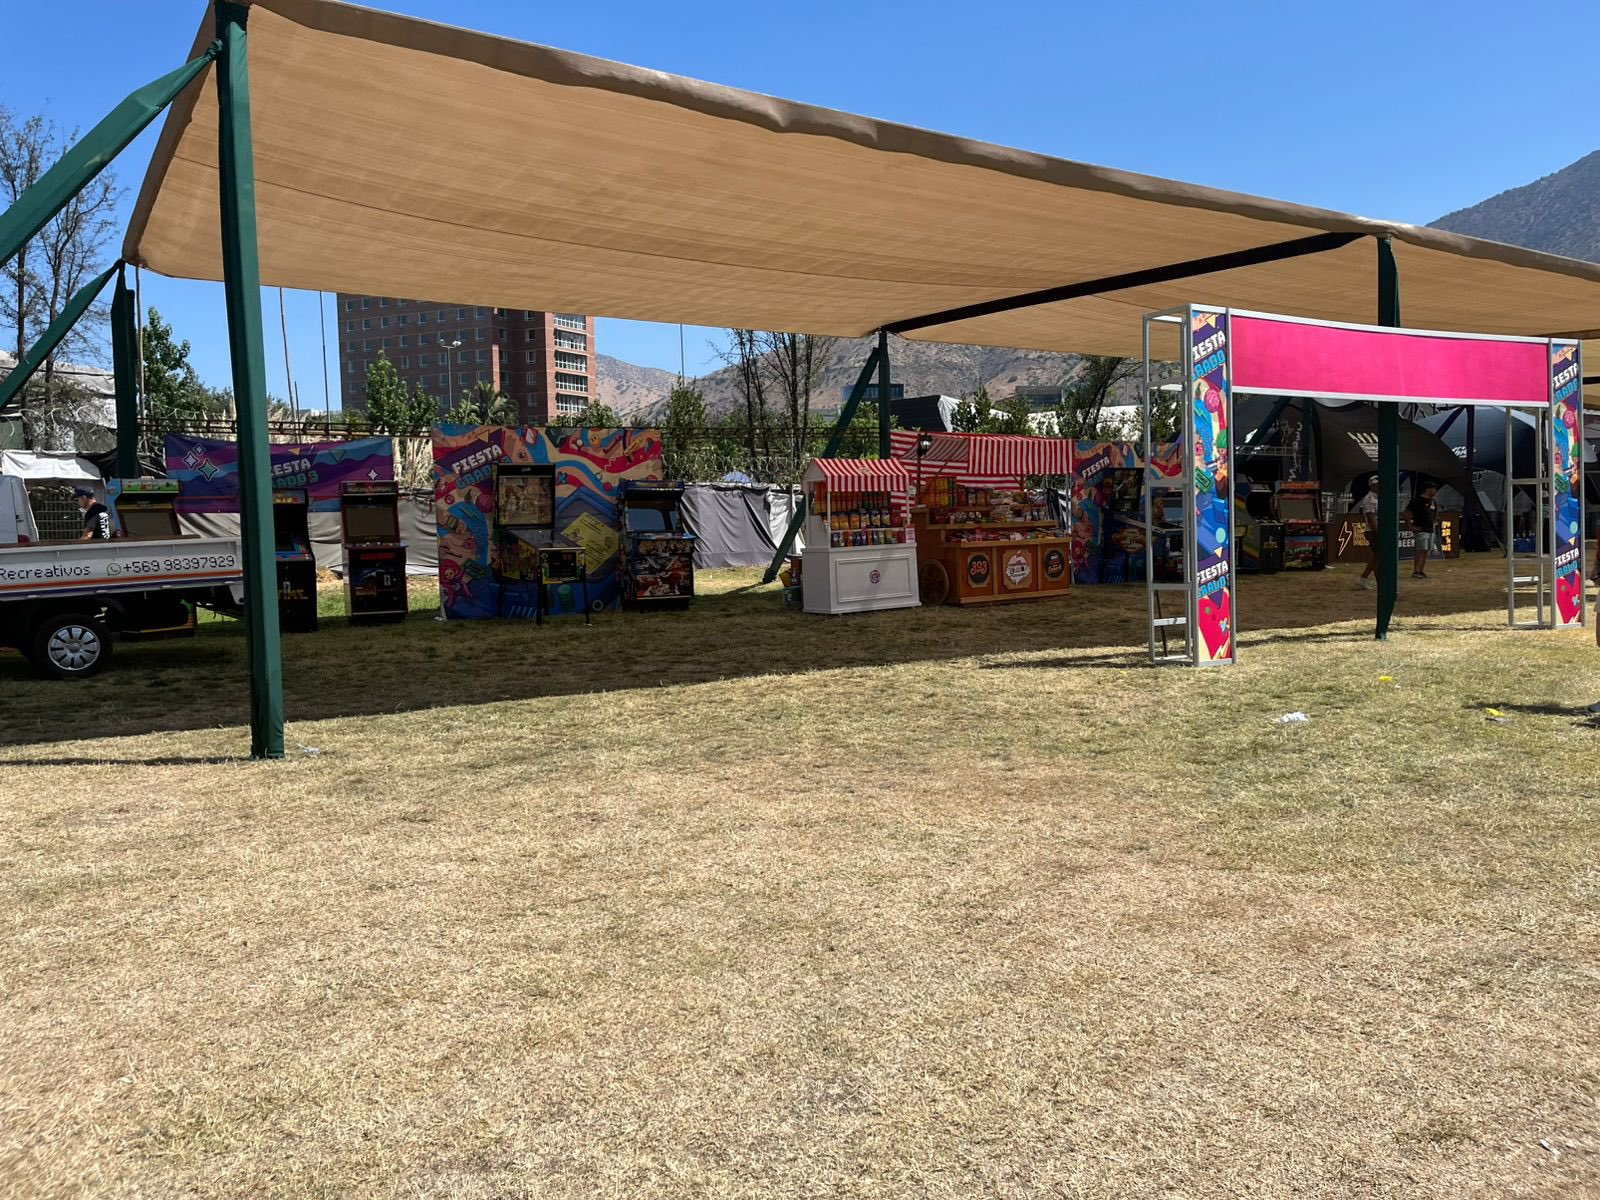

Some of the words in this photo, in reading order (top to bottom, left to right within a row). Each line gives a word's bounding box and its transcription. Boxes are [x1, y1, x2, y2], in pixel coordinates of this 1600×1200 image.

[1192, 330, 1226, 362] IESTA
[1193, 349, 1226, 381] RADO
[271, 458, 311, 476] ESTA
[452, 444, 503, 475] FIESTA
[1082, 456, 1110, 478] FIESTA
[456, 460, 499, 489] GRAD
[0, 564, 91, 580] Recreativos
[123, 561, 160, 576] +569
[163, 554, 235, 575] 98397929
